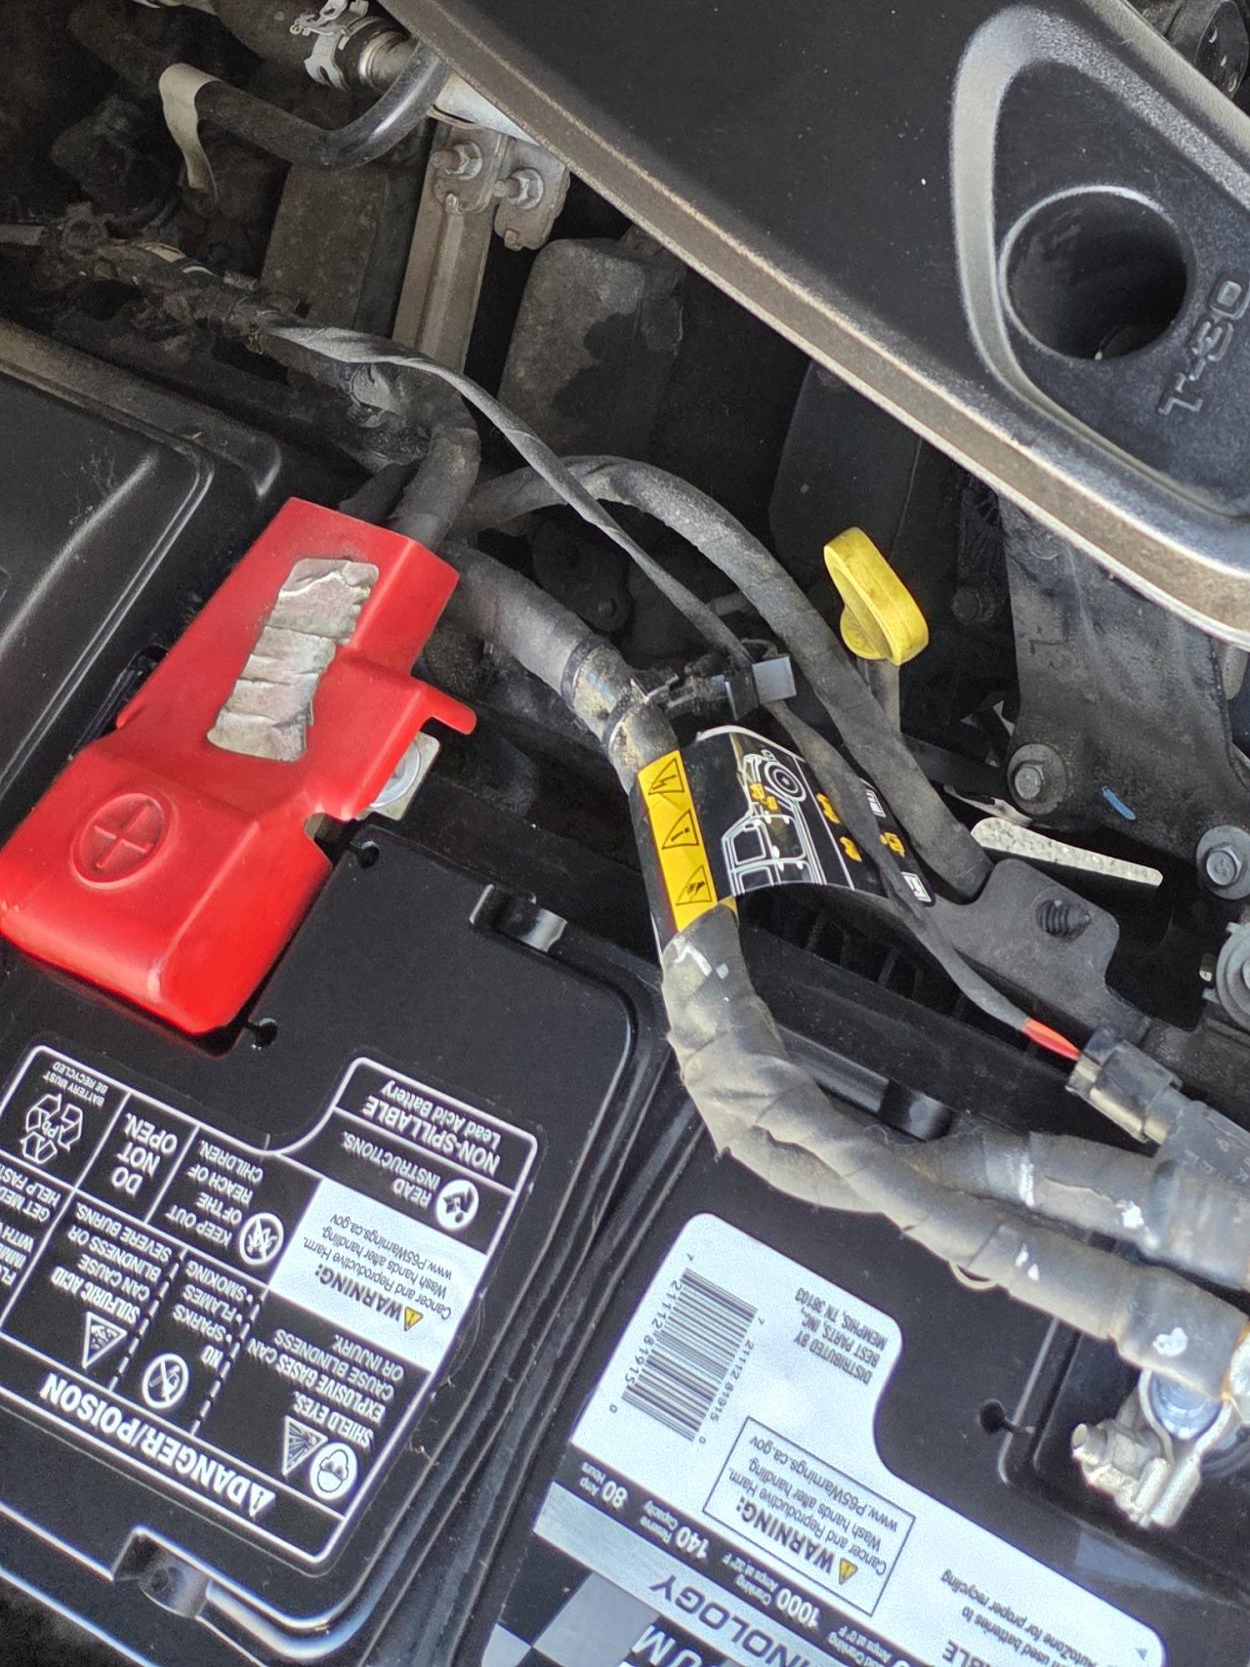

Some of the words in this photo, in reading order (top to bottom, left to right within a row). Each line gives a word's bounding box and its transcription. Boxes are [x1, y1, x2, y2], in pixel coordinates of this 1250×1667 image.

[380, 1079, 433, 1118] Battery
[123, 1112, 177, 1154] OPEN.
[361, 1094, 500, 1175] NON-SPILLABLE
[430, 1105, 466, 1132] Acid
[462, 1120, 501, 1151] Lead
[116, 1141, 160, 1176] NOT
[186, 1163, 209, 1182] OF
[199, 1139, 263, 1183] CHILDREN.
[342, 1131, 440, 1191] INSTRUCTIONS.
[25, 1182, 61, 1207] HELP
[111, 1166, 143, 1195] DO
[207, 1171, 253, 1205] REACH
[392, 1178, 432, 1207] READ
[21, 1200, 50, 1222] GET
[75, 1202, 122, 1237] BURNS.
[164, 1204, 196, 1228] OUT
[195, 1191, 223, 1217] THE
[217, 1206, 242, 1225] OF
[1, 1225, 33, 1252] WITH
[67, 1224, 89, 1245] OR
[119, 1226, 172, 1262] SEVERE
[195, 1220, 232, 1247] KEEP
[303, 1236, 332, 1261] Harm.
[321, 1225, 364, 1258] handling.
[77, 1253, 122, 1287] CAUSE
[88, 1236, 161, 1282] BLINDNESS
[331, 1251, 395, 1292] Reproductive
[362, 1248, 387, 1267] after
[386, 1259, 419, 1285] hands
[50, 1266, 84, 1294] ACID
[120, 1276, 150, 1301] CAN
[185, 1260, 247, 1301] SMOKING
[314, 1263, 402, 1321] WARNING:
[393, 1282, 416, 1300] and
[418, 1275, 447, 1300] Wash
[80, 1281, 140, 1324] SULFURIC
[182, 1283, 237, 1322] FLAMES
[414, 1293, 452, 1321] Cancer
[650, 1279, 683, 1329] 21112
[794, 1287, 826, 1314] 38103
[823, 1304, 839, 1323] TN
[172, 1303, 226, 1342] SPARKS
[799, 1306, 821, 1333] INC.,
[840, 1310, 888, 1351] MEMPHIS,
[246, 1337, 277, 1364] CAN
[273, 1328, 349, 1378] BLINDNESS
[331, 1334, 383, 1371] INJURY.
[792, 1329, 810, 1348] BY
[821, 1321, 855, 1353] PARTS,
[200, 1344, 223, 1368] NO
[275, 1353, 318, 1388] GASES
[380, 1359, 404, 1382] OR
[624, 1333, 655, 1384] 81915
[808, 1338, 872, 1385] DISTRIBUTED
[852, 1343, 880, 1368] BEST
[315, 1374, 385, 1423] EXPLOSIVE
[346, 1366, 394, 1401] CAUSE
[292, 1390, 329, 1425] EYES.
[42, 1375, 251, 1504] DANGER/POISON
[326, 1411, 373, 1448] SHIELD
[728, 1469, 758, 1497] Harm.
[747, 1456, 793, 1498] handling.
[748, 1435, 898, 1532] www.P65Warnings.ca.gov
[601, 1480, 627, 1508] 80
[791, 1488, 817, 1509] after
[758, 1487, 826, 1539] Reproductive
[816, 1502, 851, 1533] hands
[675, 1526, 708, 1558] 140
[735, 1496, 834, 1574] WARNING:
[824, 1528, 848, 1550] and
[850, 1523, 881, 1553] Wash
[847, 1543, 887, 1577] Cancer
[939, 1568, 990, 1607] recycling
[648, 1574, 810, 1667] NOLOGY
[775, 1587, 819, 1627] 1000
[961, 1605, 974, 1623] to
[986, 1601, 1028, 1629] proper
[973, 1613, 1023, 1652] batteries
[1023, 1623, 1043, 1642] for
[1019, 1643, 1050, 1667] used
